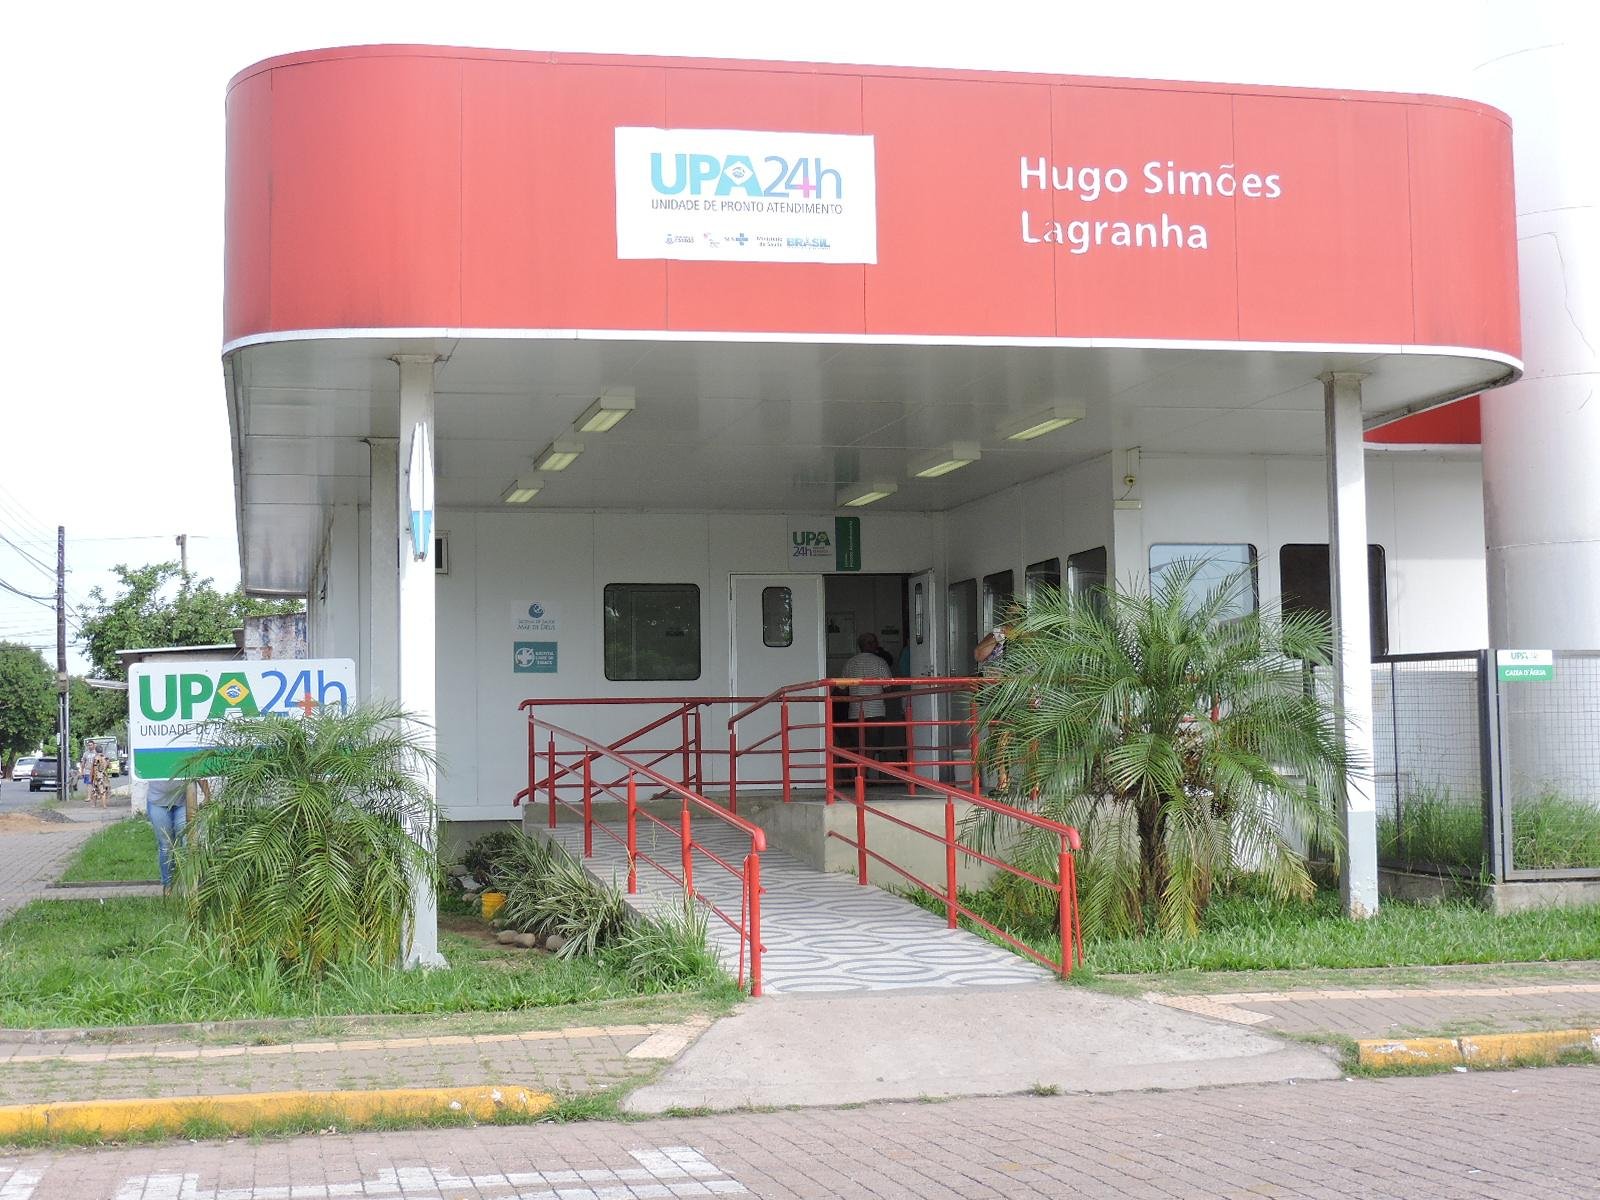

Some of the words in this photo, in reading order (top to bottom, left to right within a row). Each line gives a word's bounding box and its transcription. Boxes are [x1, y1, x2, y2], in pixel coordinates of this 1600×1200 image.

[1019, 156, 1129, 201] Hugo
[1143, 160, 1282, 198] Simões
[651, 199, 701, 211] UNIDADE
[703, 200, 718, 212] DE
[721, 201, 764, 213] PRONTO
[766, 202, 844, 215] ATENDIMENTO
[1021, 210, 1209, 254] Lagranha
[792, 531, 831, 546] UPA
[792, 546, 812, 557] 24h
[140, 724, 192, 736] UNIDADE
